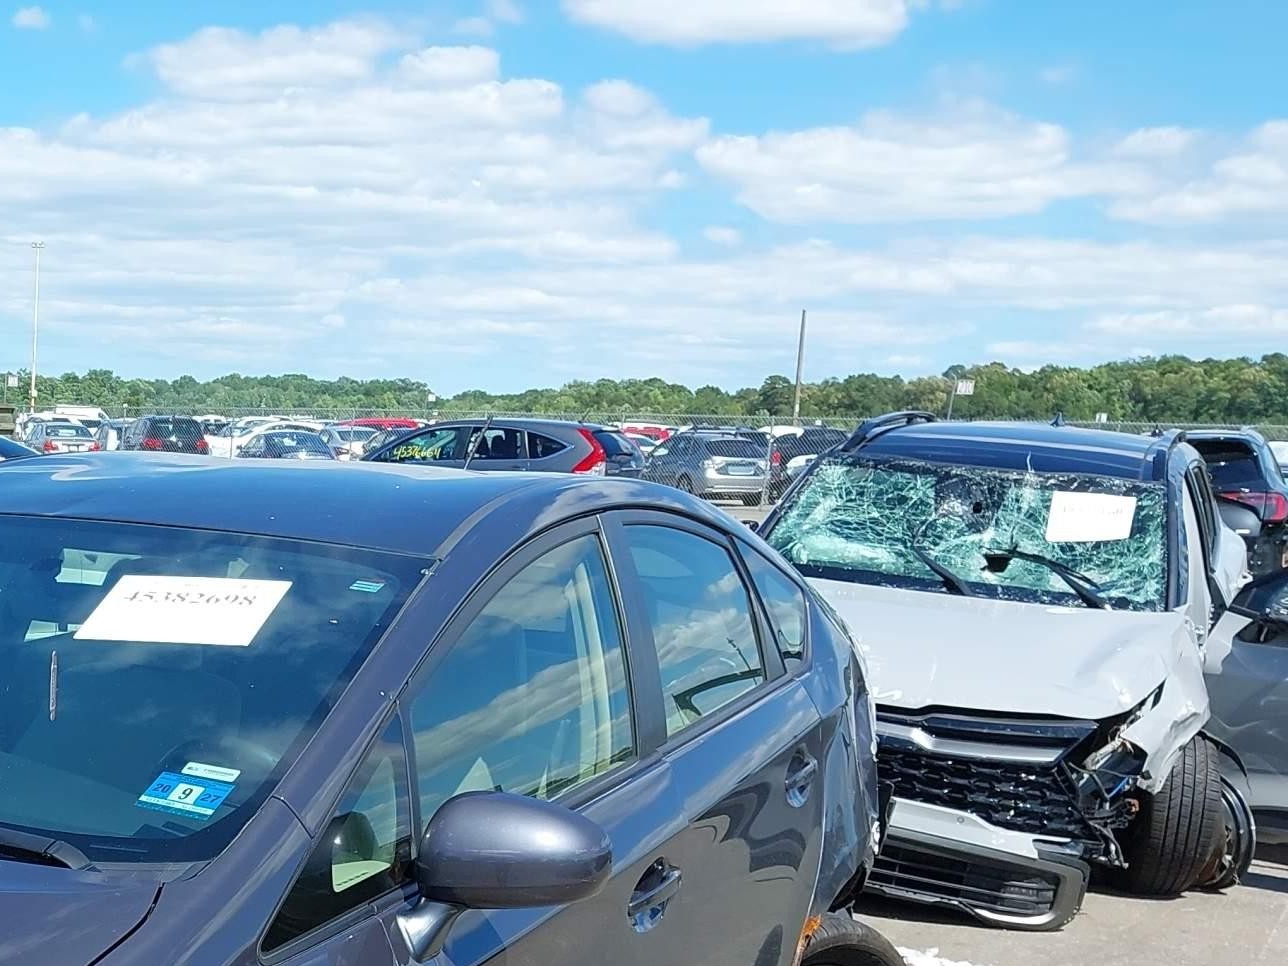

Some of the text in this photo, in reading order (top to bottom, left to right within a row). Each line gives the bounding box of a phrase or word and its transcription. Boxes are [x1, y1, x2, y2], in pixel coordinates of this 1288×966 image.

[123, 591, 257, 605] 45382698
[153, 784, 221, 804] 20 9 27
